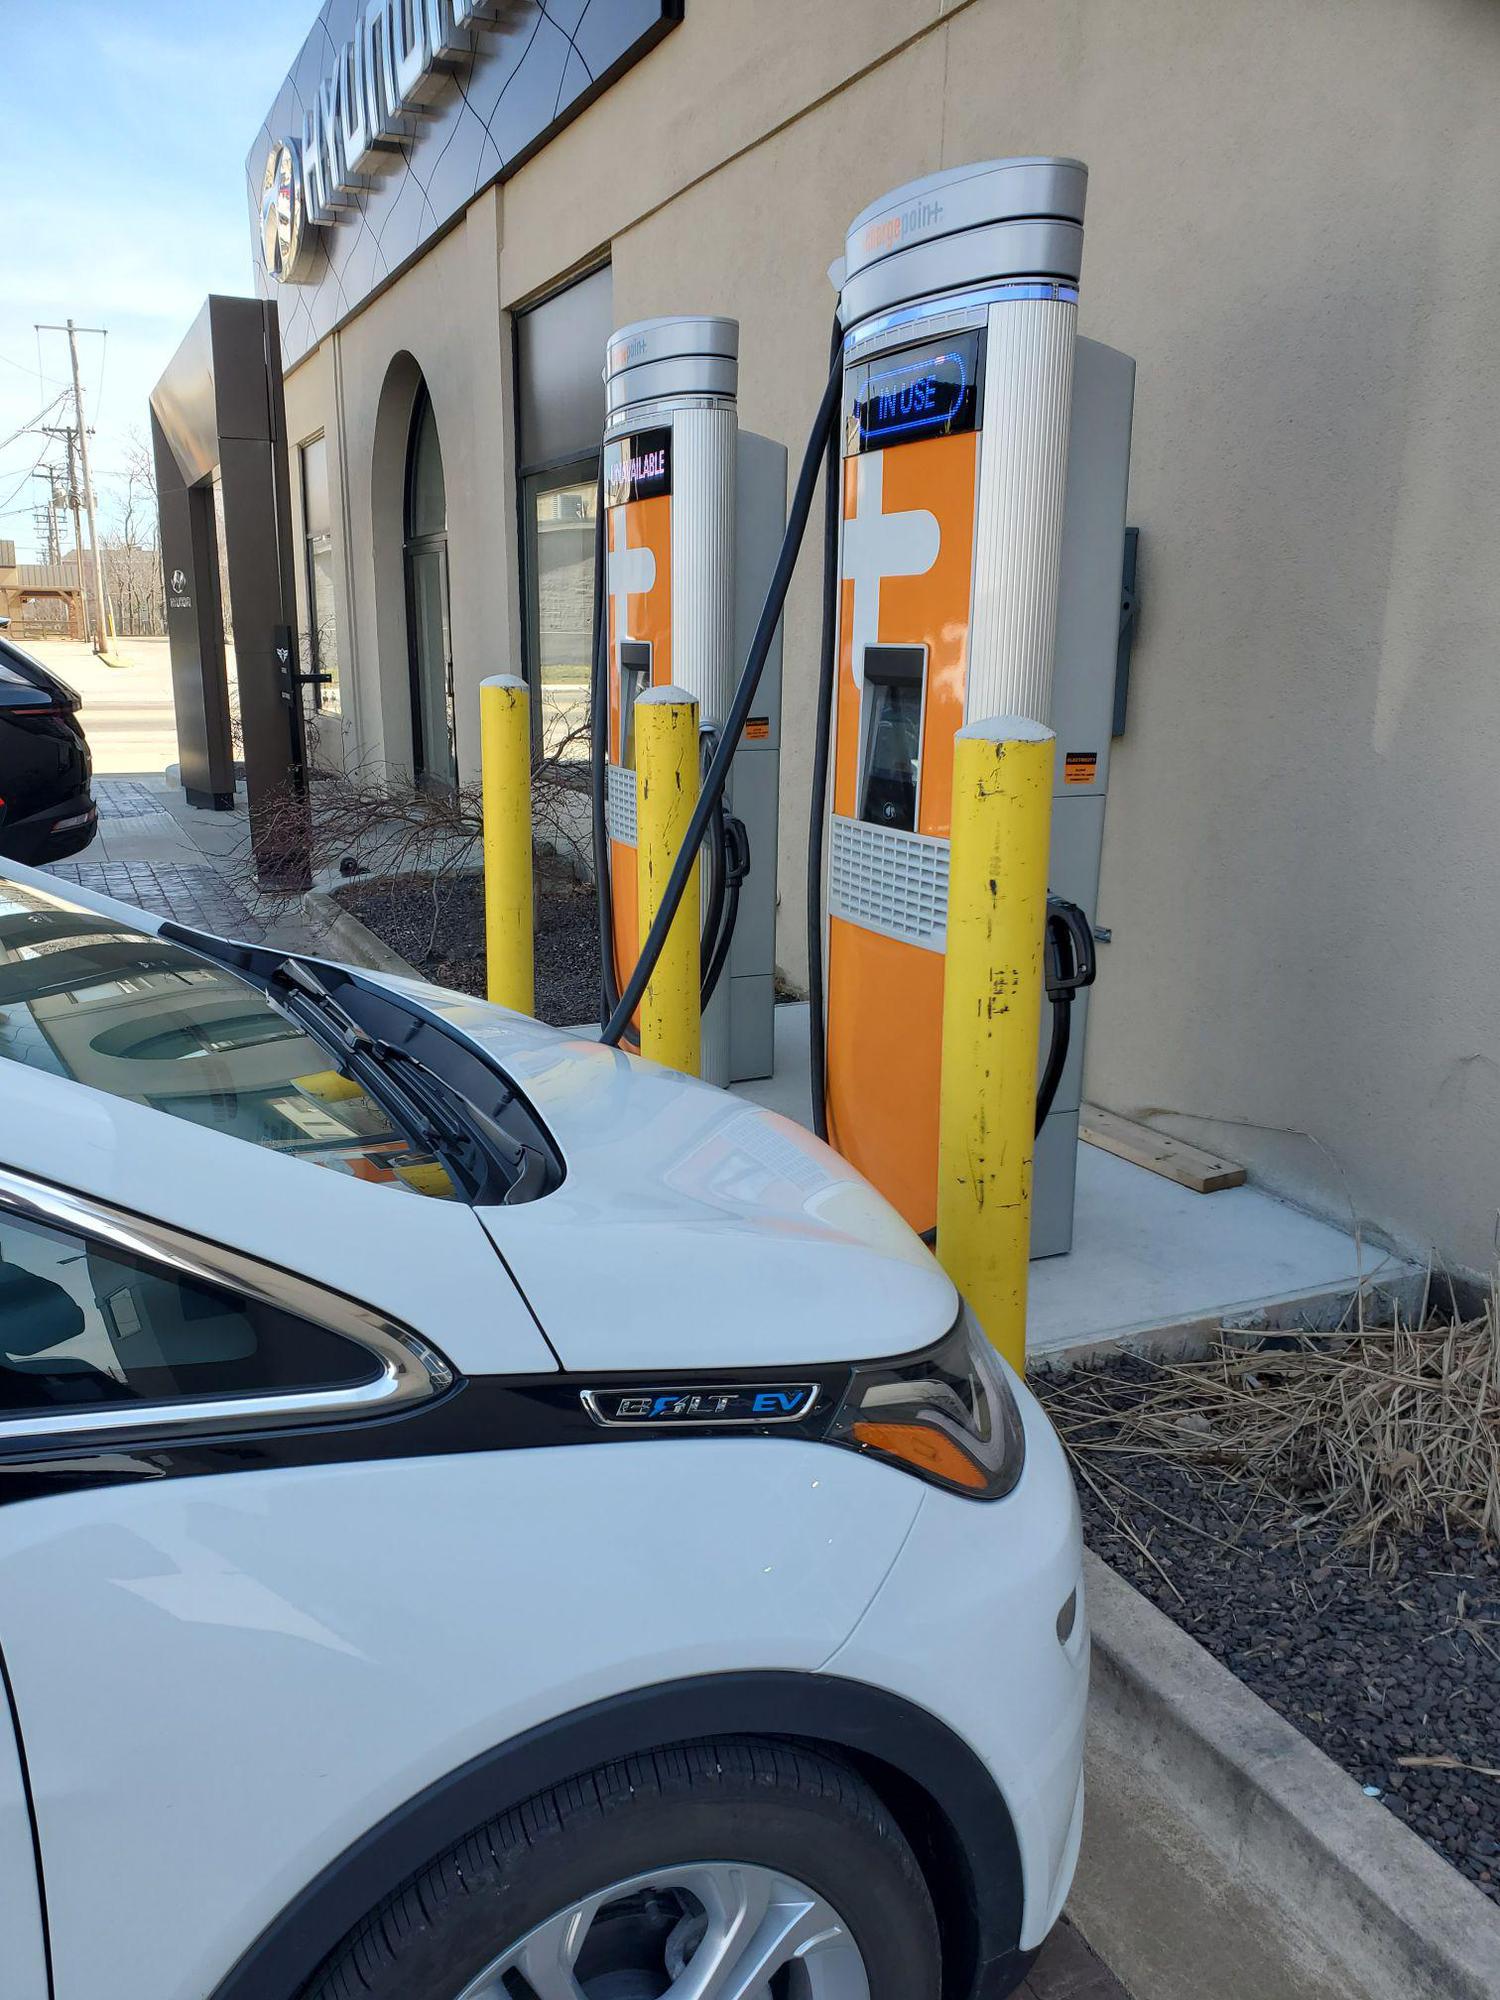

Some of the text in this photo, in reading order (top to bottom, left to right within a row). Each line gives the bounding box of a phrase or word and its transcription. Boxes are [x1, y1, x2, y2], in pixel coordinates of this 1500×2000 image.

[878, 374, 937, 420] IN USE
[611, 449, 665, 483] UNAVAILABLE
[753, 1391, 804, 1413] EV
